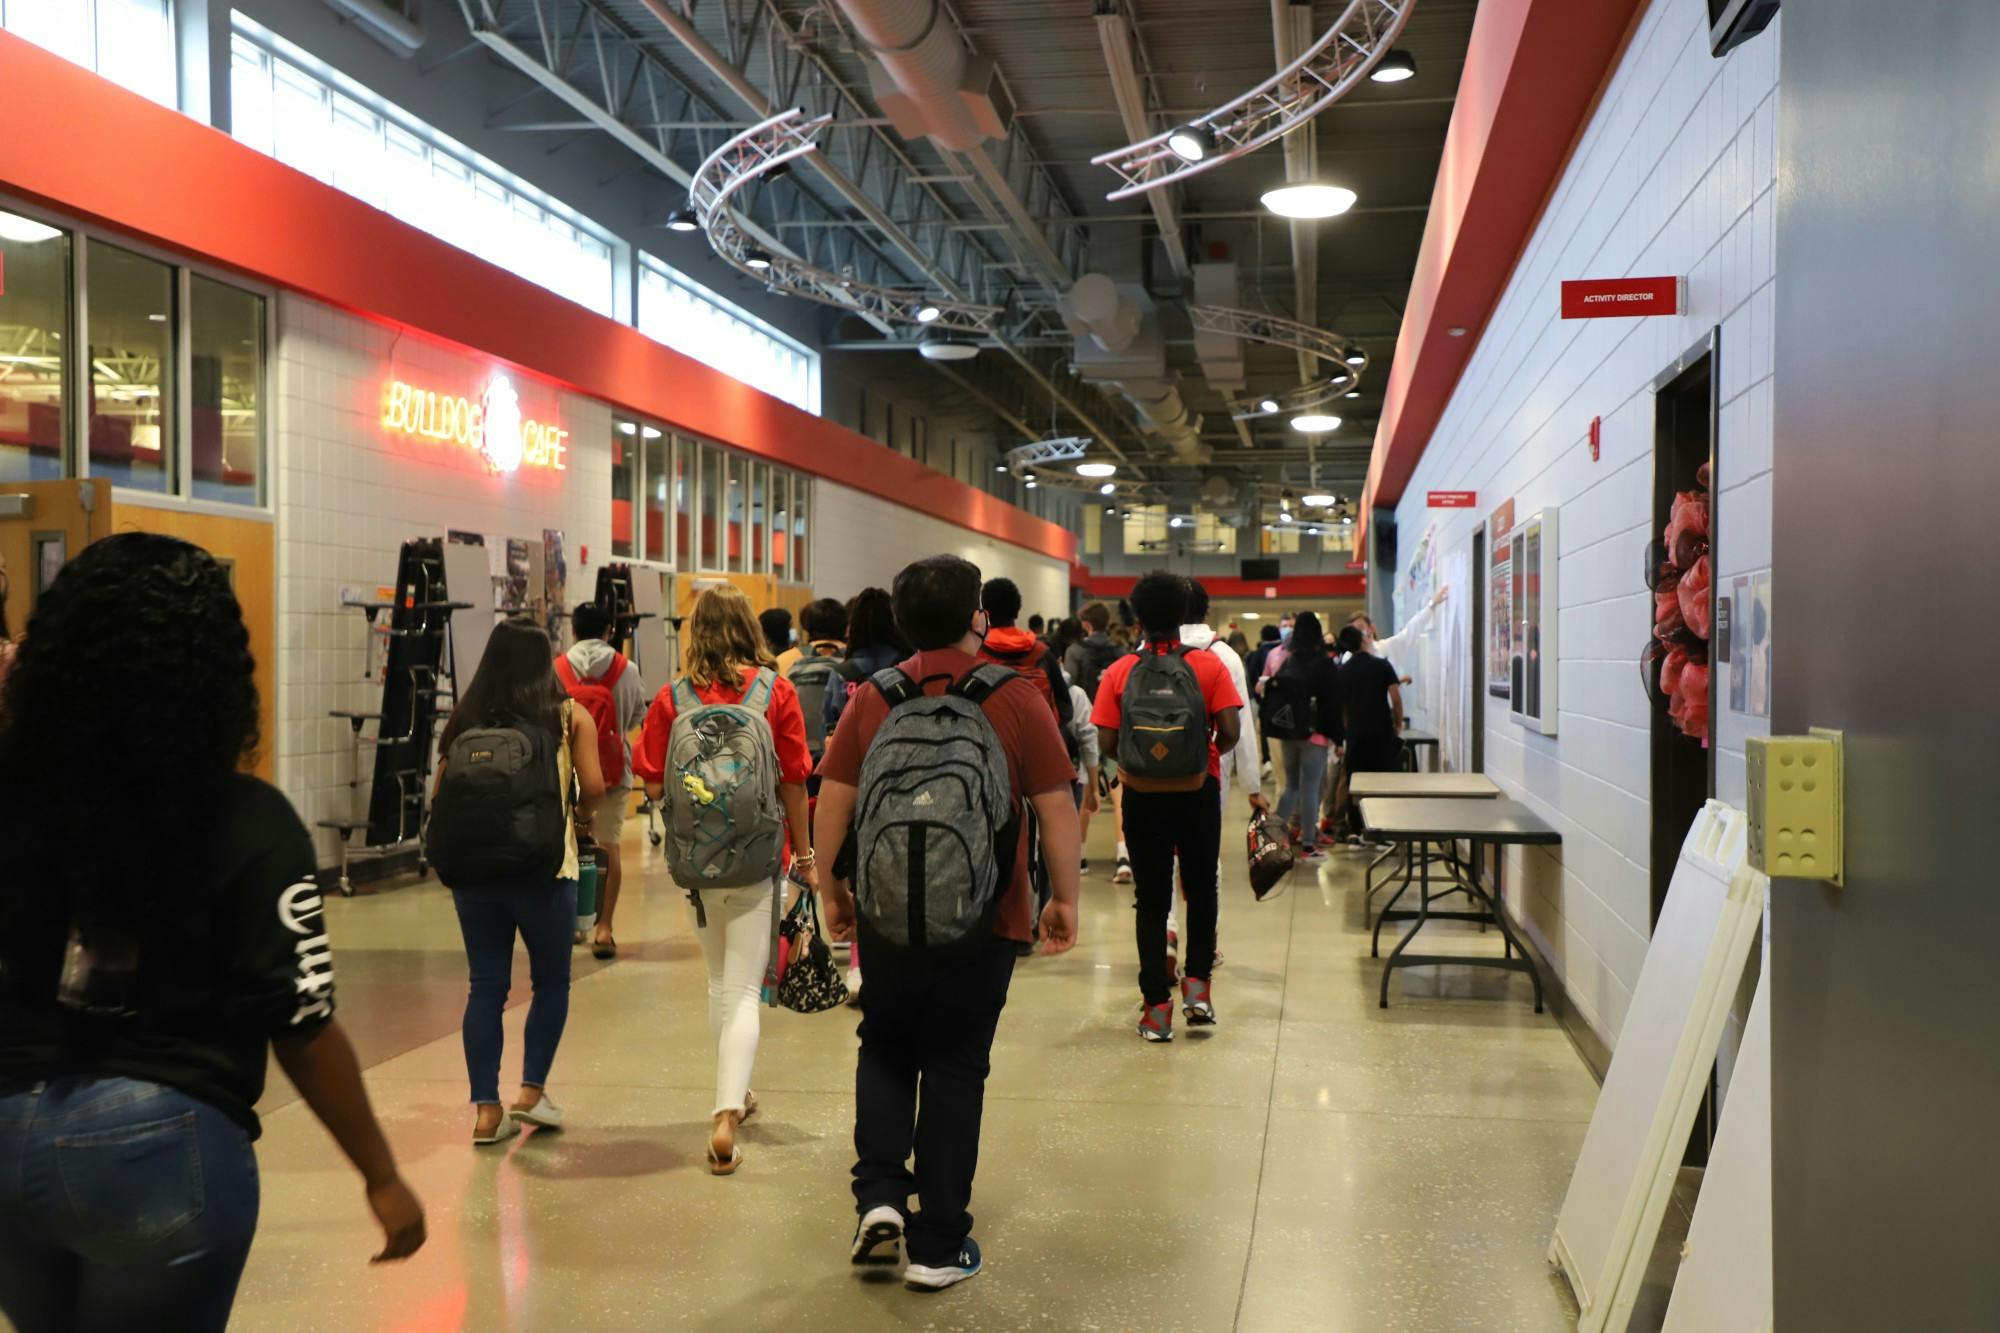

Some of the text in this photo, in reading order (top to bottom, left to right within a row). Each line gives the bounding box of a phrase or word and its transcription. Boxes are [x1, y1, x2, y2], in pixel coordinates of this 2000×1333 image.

[1583, 292, 1654, 303] ACTIVITY DIRECTOR
[383, 380, 569, 470] BULLDOG CAFE
